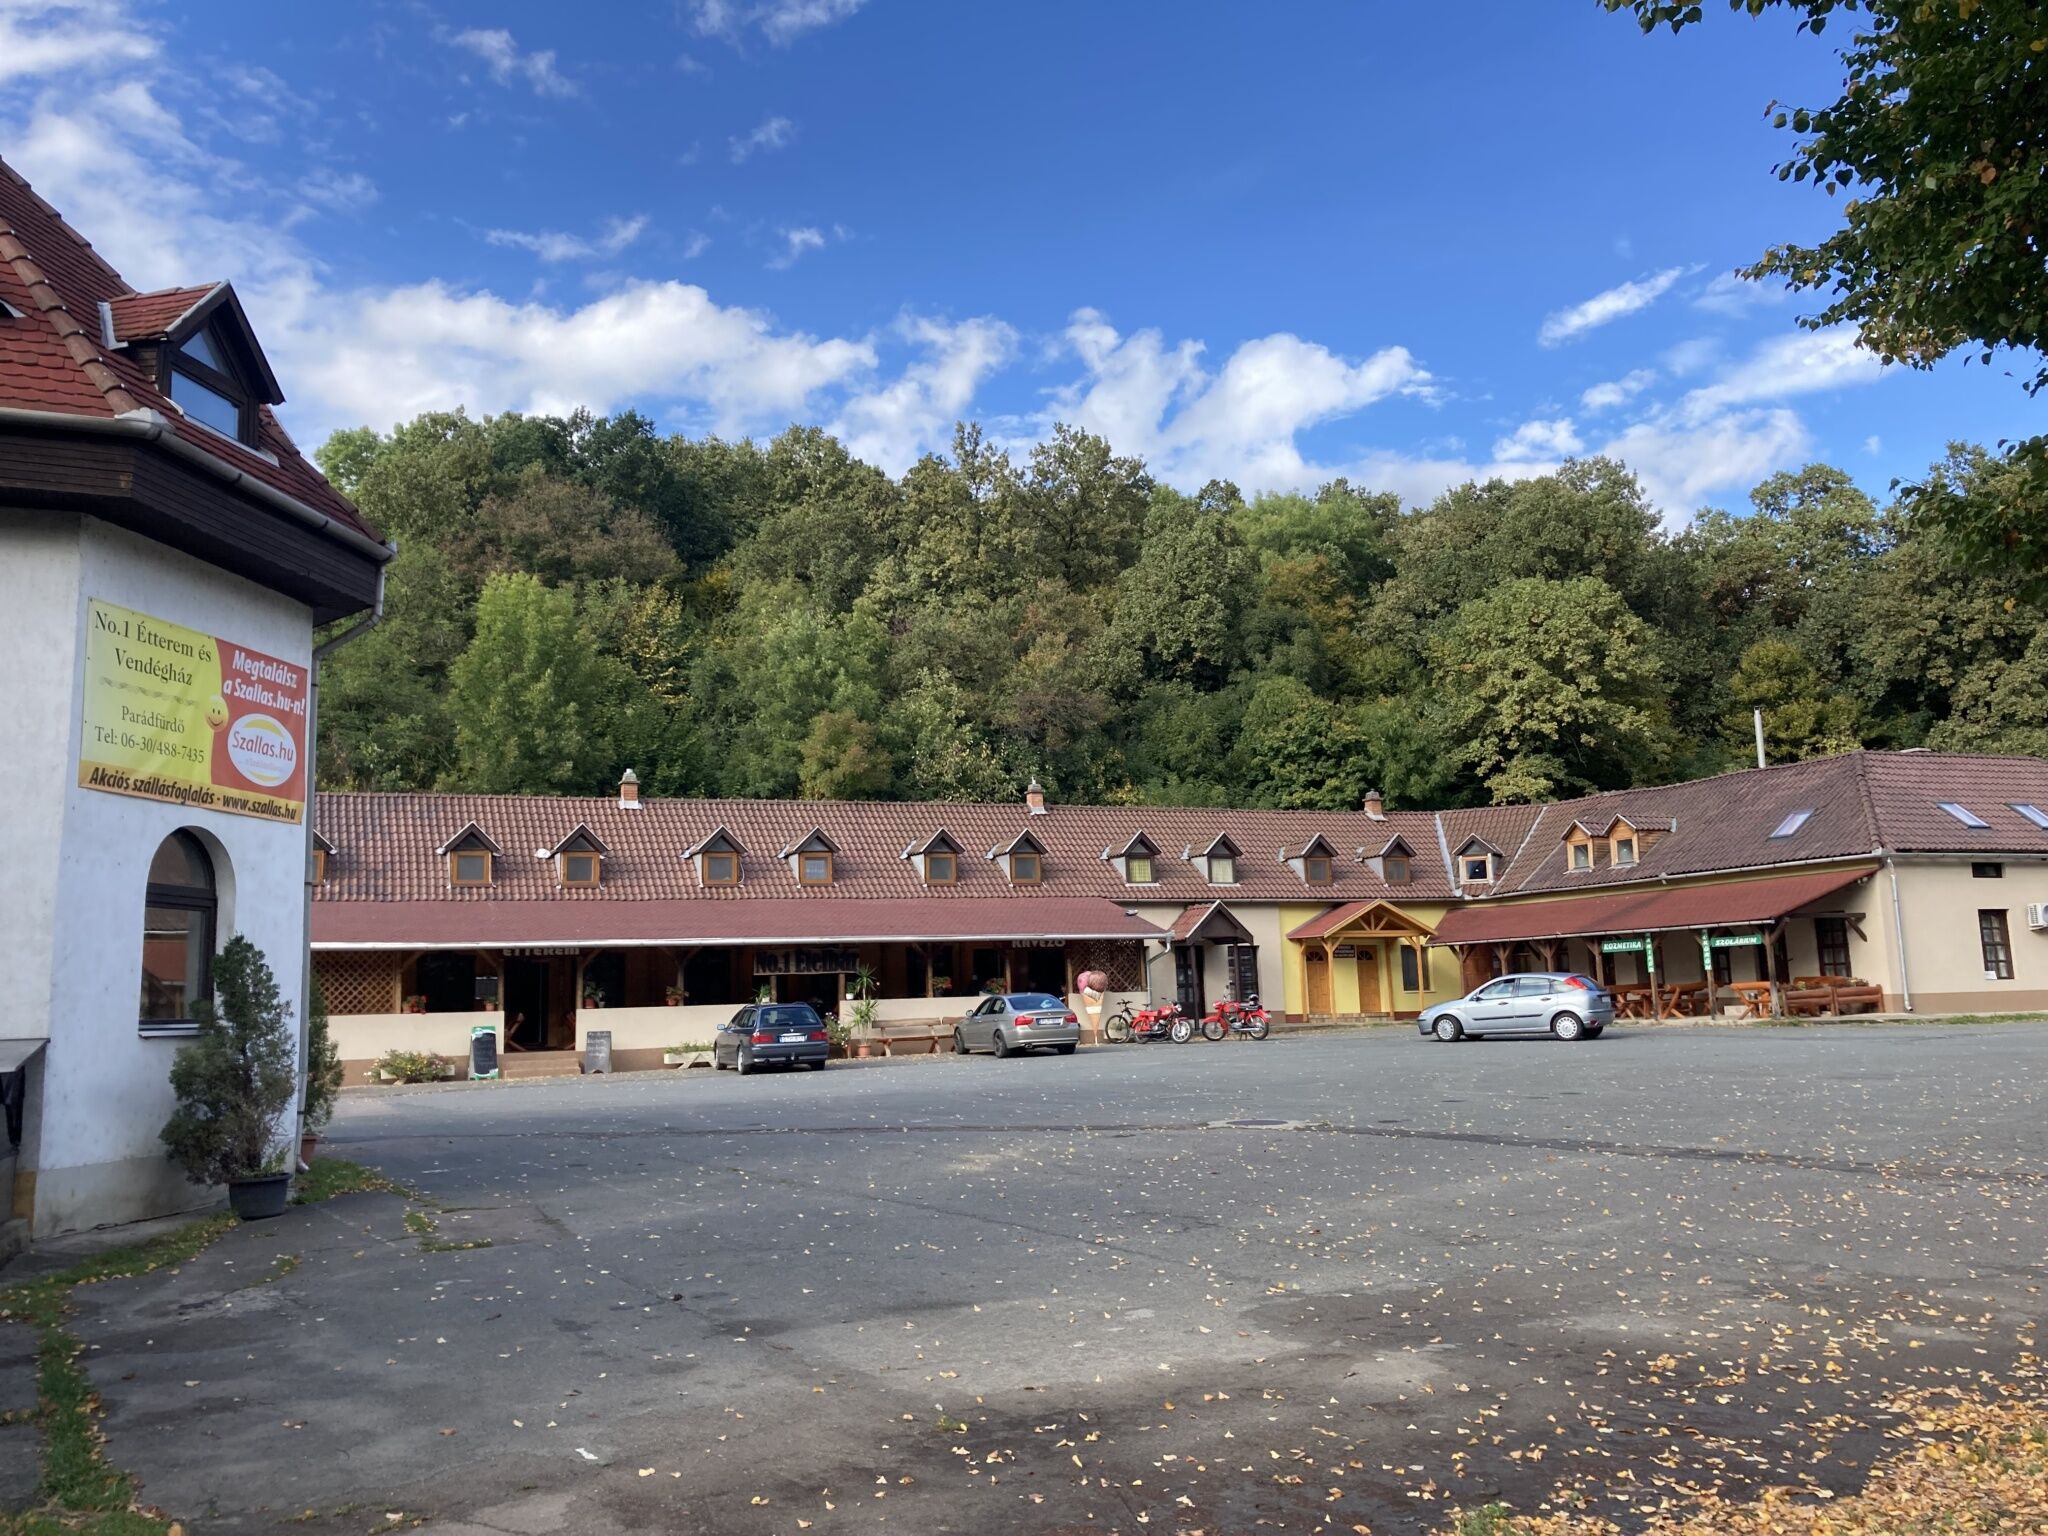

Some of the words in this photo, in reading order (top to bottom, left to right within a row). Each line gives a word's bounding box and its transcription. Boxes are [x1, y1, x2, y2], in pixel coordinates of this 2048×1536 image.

[95, 610, 130, 639] No.1
[136, 620, 194, 658] Étterem
[198, 643, 212, 663] és
[115, 647, 193, 686] Vendégház
[232, 650, 298, 689] Megtalálsz
[223, 679, 232, 695] a
[233, 678, 306, 716] Szallas.hu-n!
[94, 725, 118, 745] Tel:
[232, 730, 294, 763] Szallas.hu
[88, 766, 130, 791] Akciós
[132, 777, 214, 806] szállásfoglalás
[222, 795, 297, 820] www.szallas.hu
